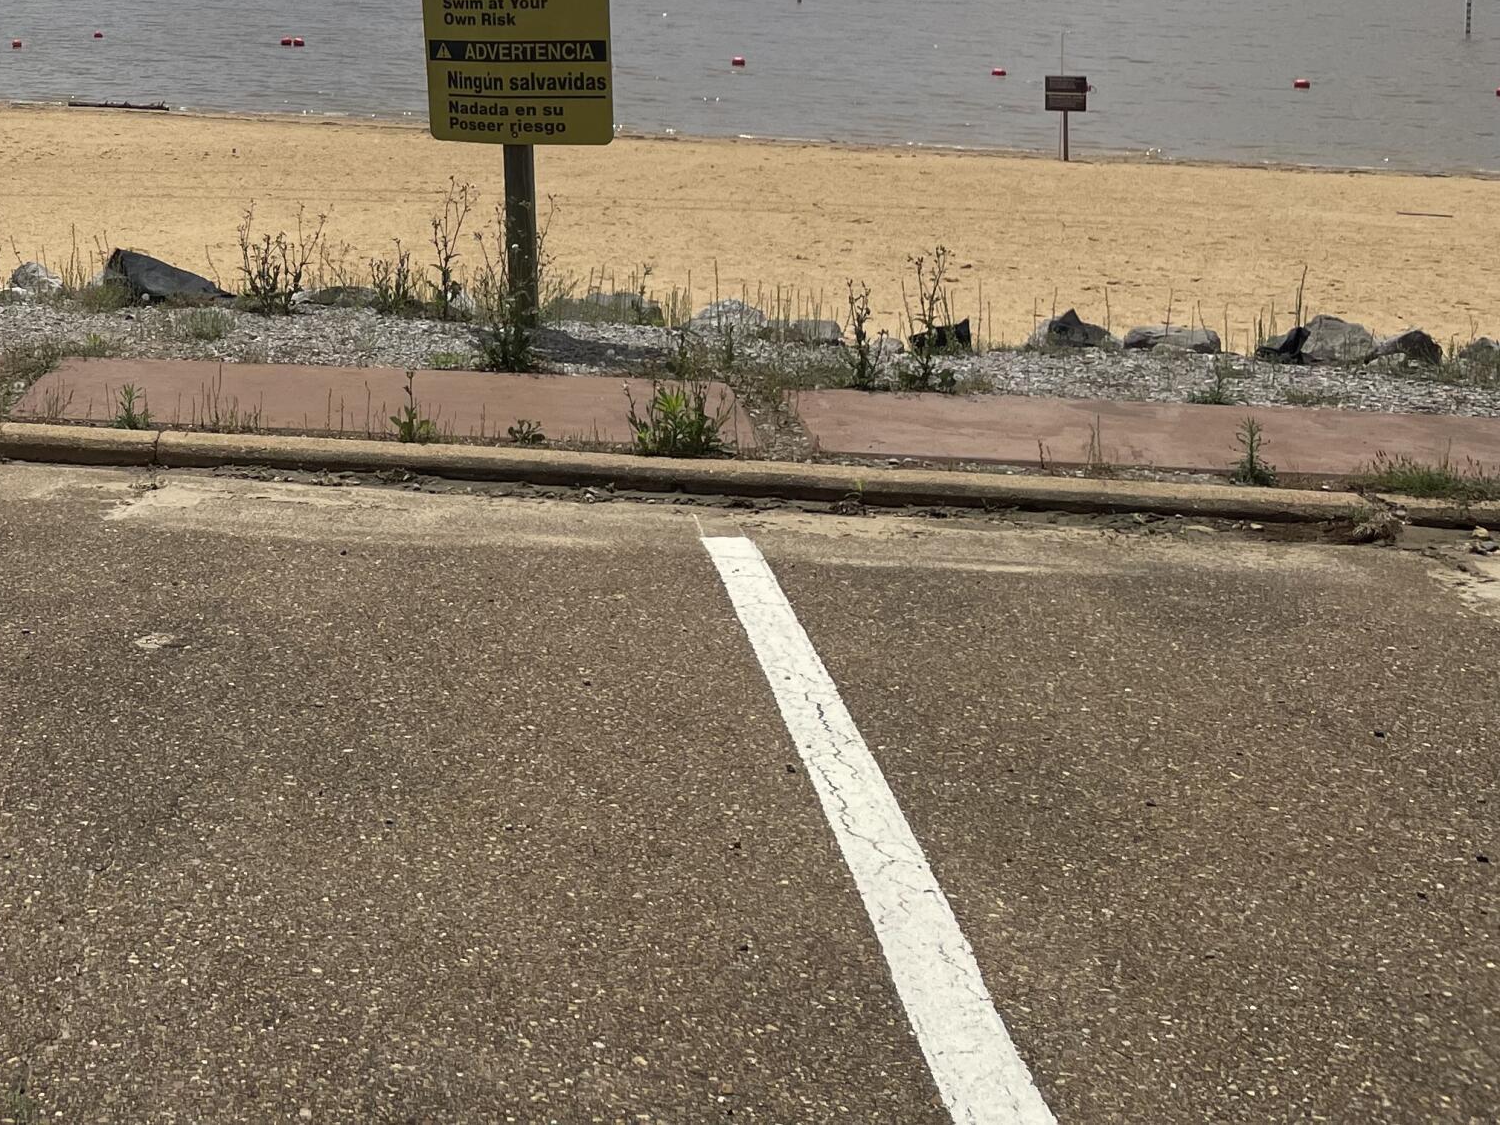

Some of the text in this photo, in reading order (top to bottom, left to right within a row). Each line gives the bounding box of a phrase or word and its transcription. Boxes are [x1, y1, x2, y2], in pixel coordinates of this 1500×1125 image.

[444, 13, 516, 25] Own Risk
[465, 43, 594, 60] ADVERTENCIA
[510, 72, 606, 90] salvavidas
[449, 101, 563, 116] Nadada en su
[510, 120, 566, 135] riesgo
